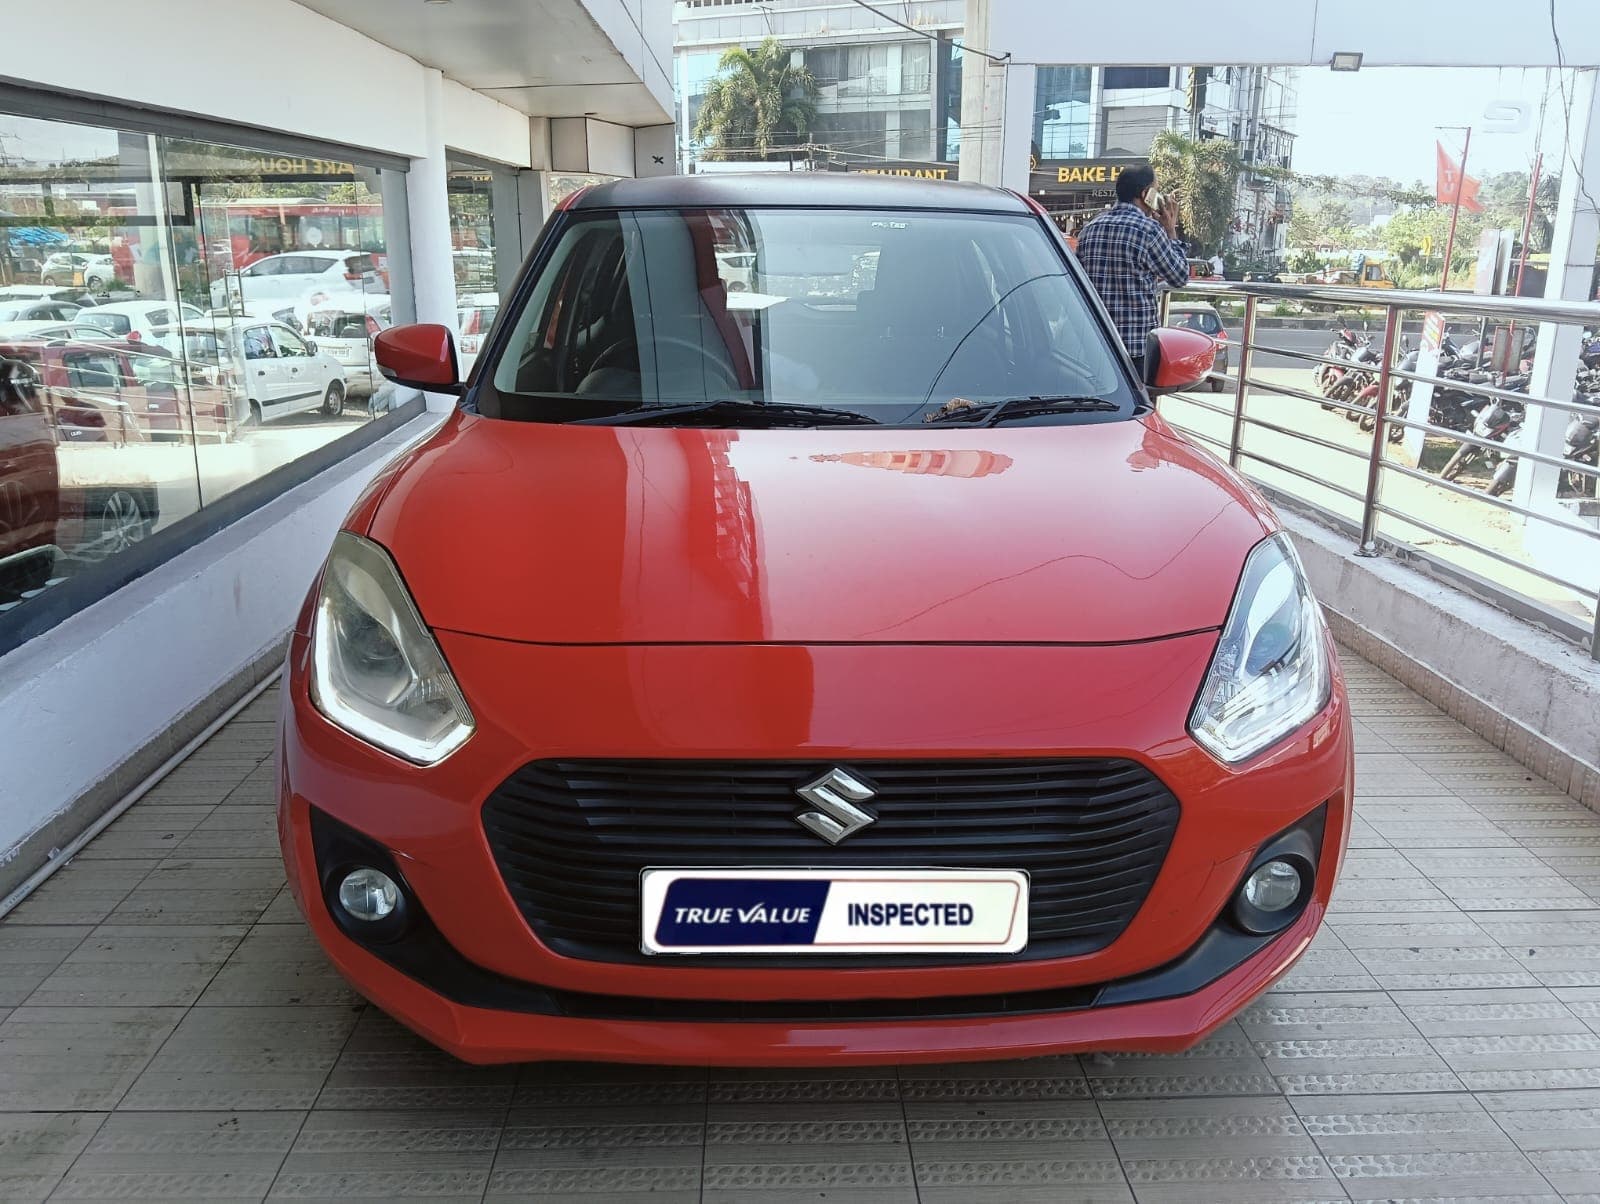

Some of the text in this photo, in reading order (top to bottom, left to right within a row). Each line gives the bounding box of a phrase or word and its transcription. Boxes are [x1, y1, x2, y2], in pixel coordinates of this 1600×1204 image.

[1058, 166, 1124, 183] BAKE H
[675, 903, 974, 926] TRUE VALUE INSPECTED
